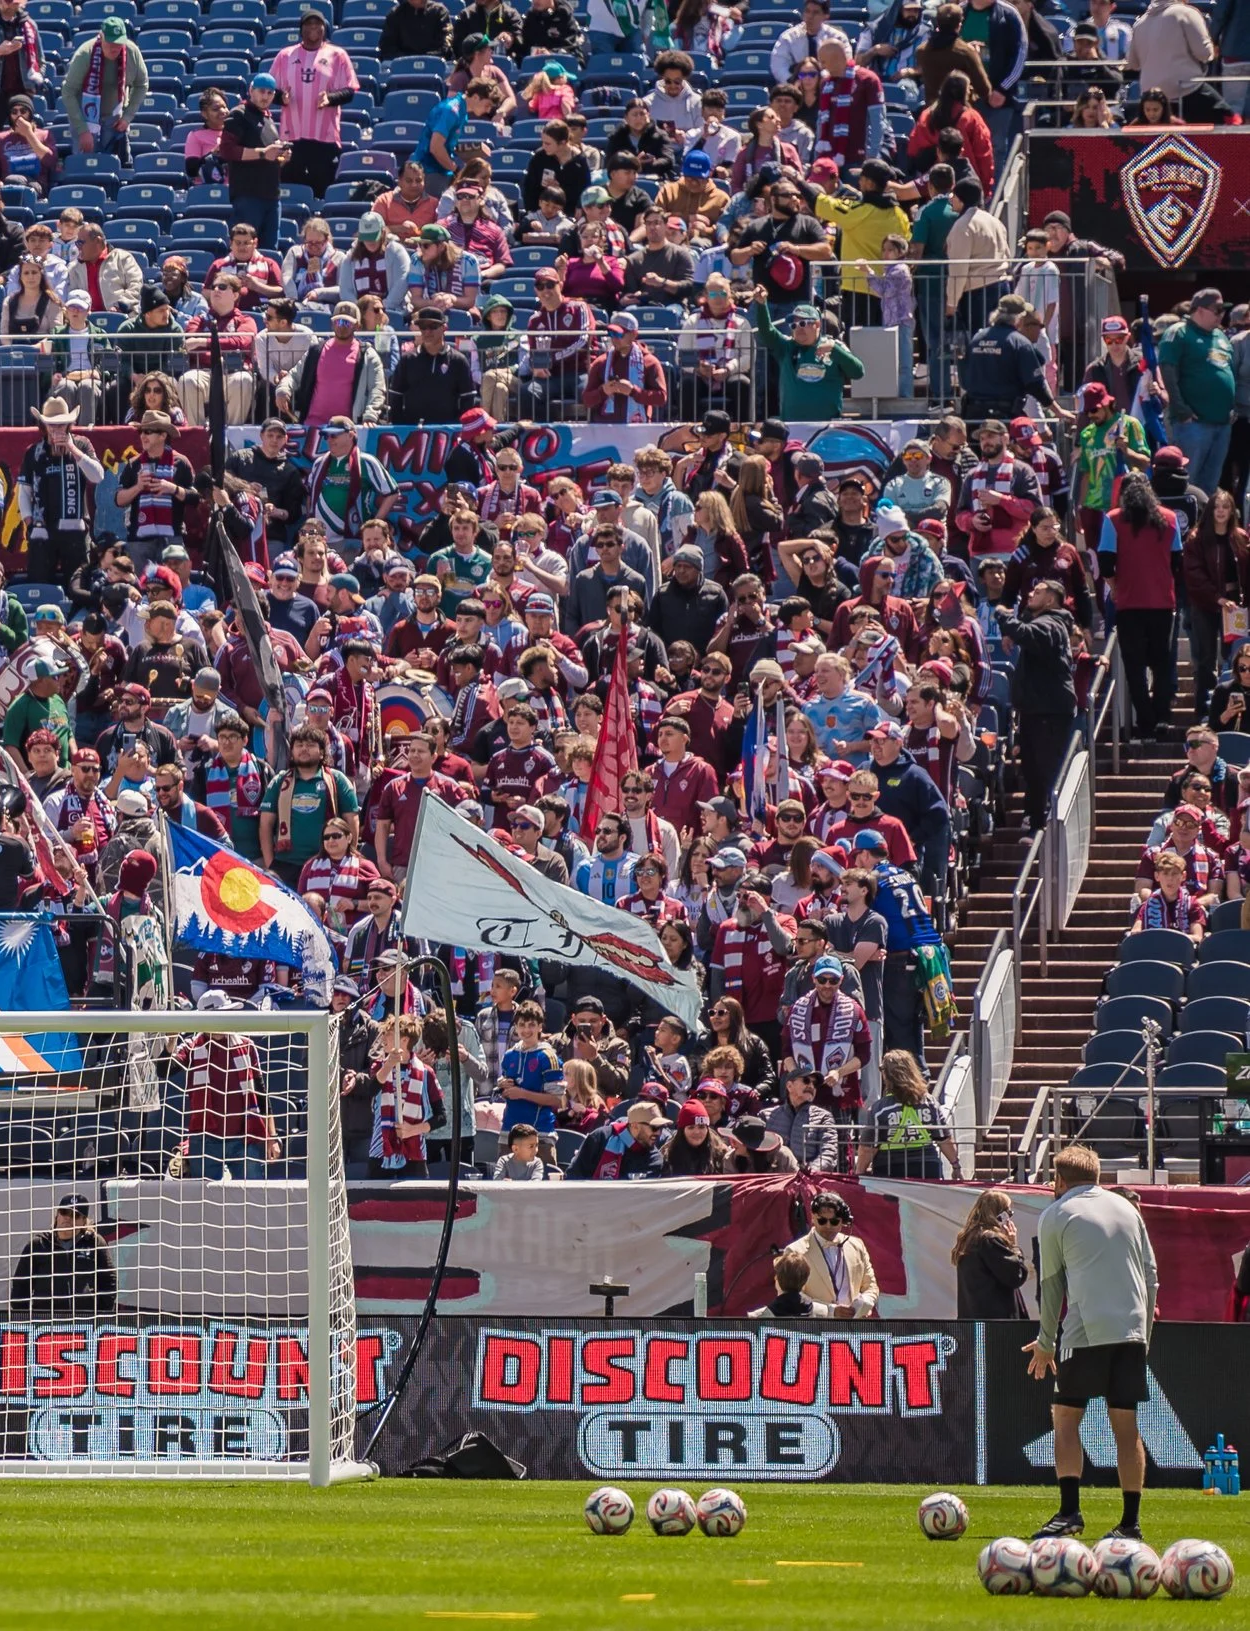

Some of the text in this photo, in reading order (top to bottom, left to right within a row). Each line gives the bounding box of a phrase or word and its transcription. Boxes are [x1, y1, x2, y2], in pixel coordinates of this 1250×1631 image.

[65, 463, 76, 515] BELONG
[497, 774, 532, 788] uchealth
[601, 881, 616, 899] 10
[892, 885, 930, 918] 20
[210, 975, 252, 986] uchealth
[888, 1106, 932, 1124] arus
[59, 1413, 254, 1456] TIRE
[609, 1421, 806, 1465] TIRE
